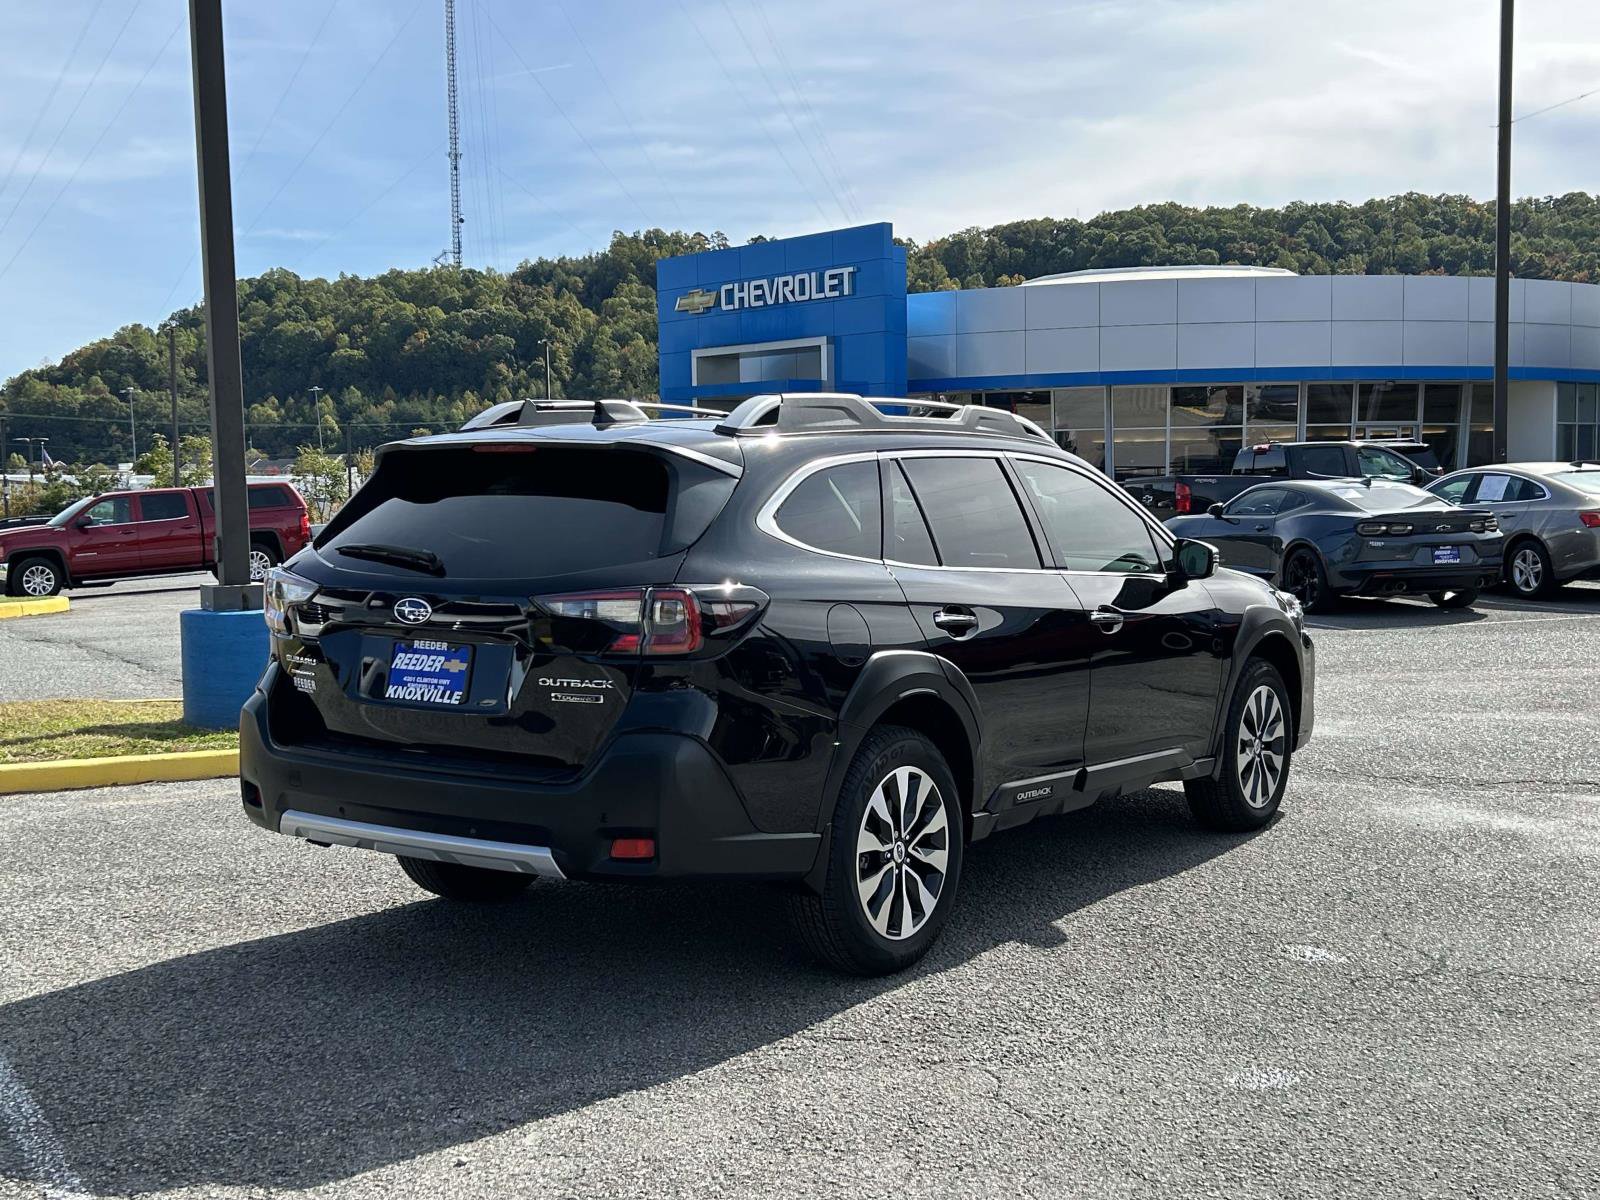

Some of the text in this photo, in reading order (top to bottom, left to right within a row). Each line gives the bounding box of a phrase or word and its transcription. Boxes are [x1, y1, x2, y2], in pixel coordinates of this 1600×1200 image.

[720, 266, 857, 311] CHEVROLET
[413, 640, 448, 651] REEDER
[391, 652, 446, 672] REEDER
[538, 678, 615, 689] OUTBACK
[385, 685, 463, 704] KNOXVILLE
[1016, 787, 1052, 800] OUTBACK
